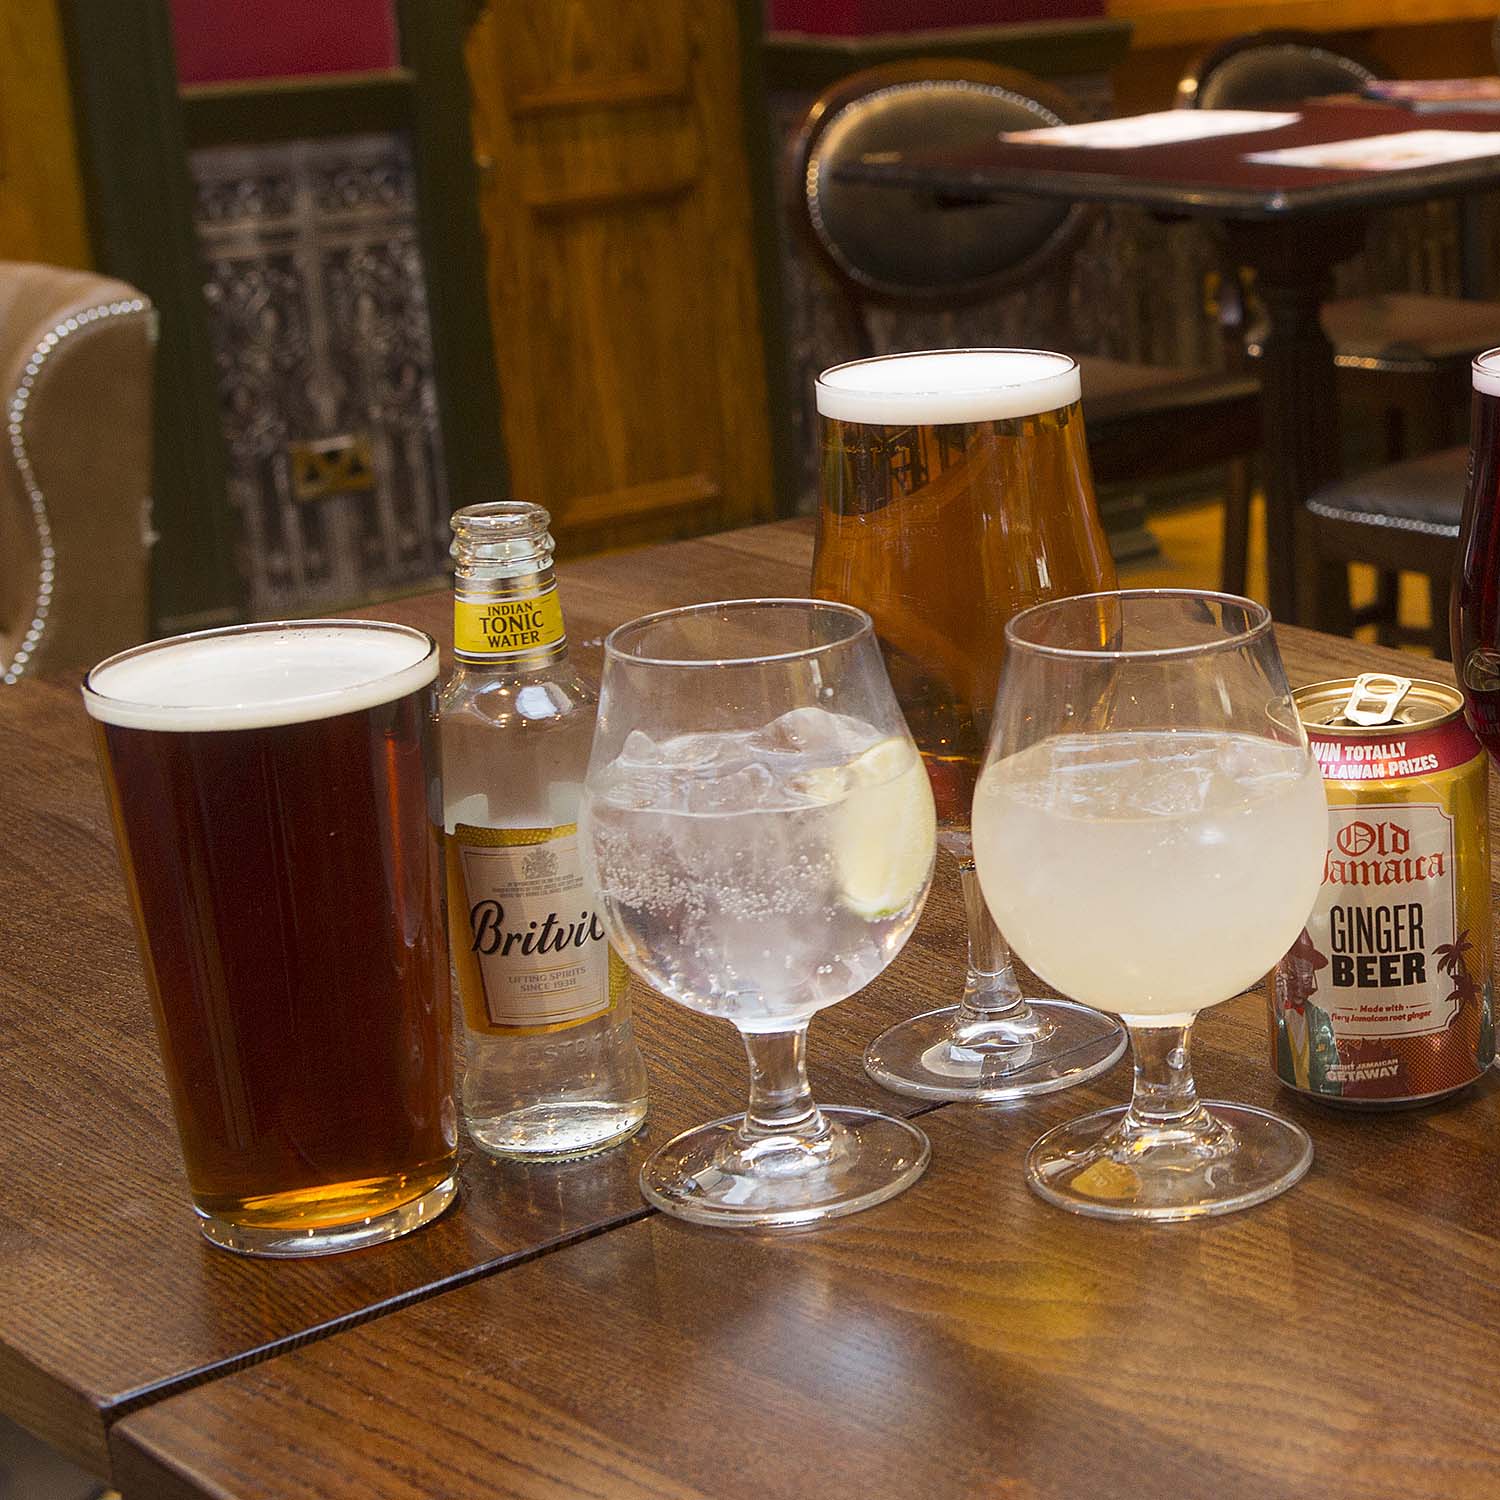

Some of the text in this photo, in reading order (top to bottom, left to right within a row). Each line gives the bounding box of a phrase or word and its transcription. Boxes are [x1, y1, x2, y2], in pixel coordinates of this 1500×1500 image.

[488, 601, 533, 617] INDIAN
[479, 611, 544, 635] TONIC
[487, 631, 541, 648] WATER
[1311, 742, 1407, 762] WIN TOTALLY
[1388, 754, 1439, 776] PRIZES
[1336, 820, 1410, 857] Old
[1329, 902, 1425, 954] GINGER
[507, 965, 587, 985] LIFTING SPIRITS
[1331, 951, 1428, 988] BEER
[520, 977, 577, 993] SINCE 1938
[1350, 1013, 1389, 1022] Jamaican
[1389, 1012, 1407, 1021] root
[1407, 1010, 1433, 1022] ginger
[1359, 1003, 1405, 1013] Made with
[1326, 1065, 1399, 1082] GETAWAY
